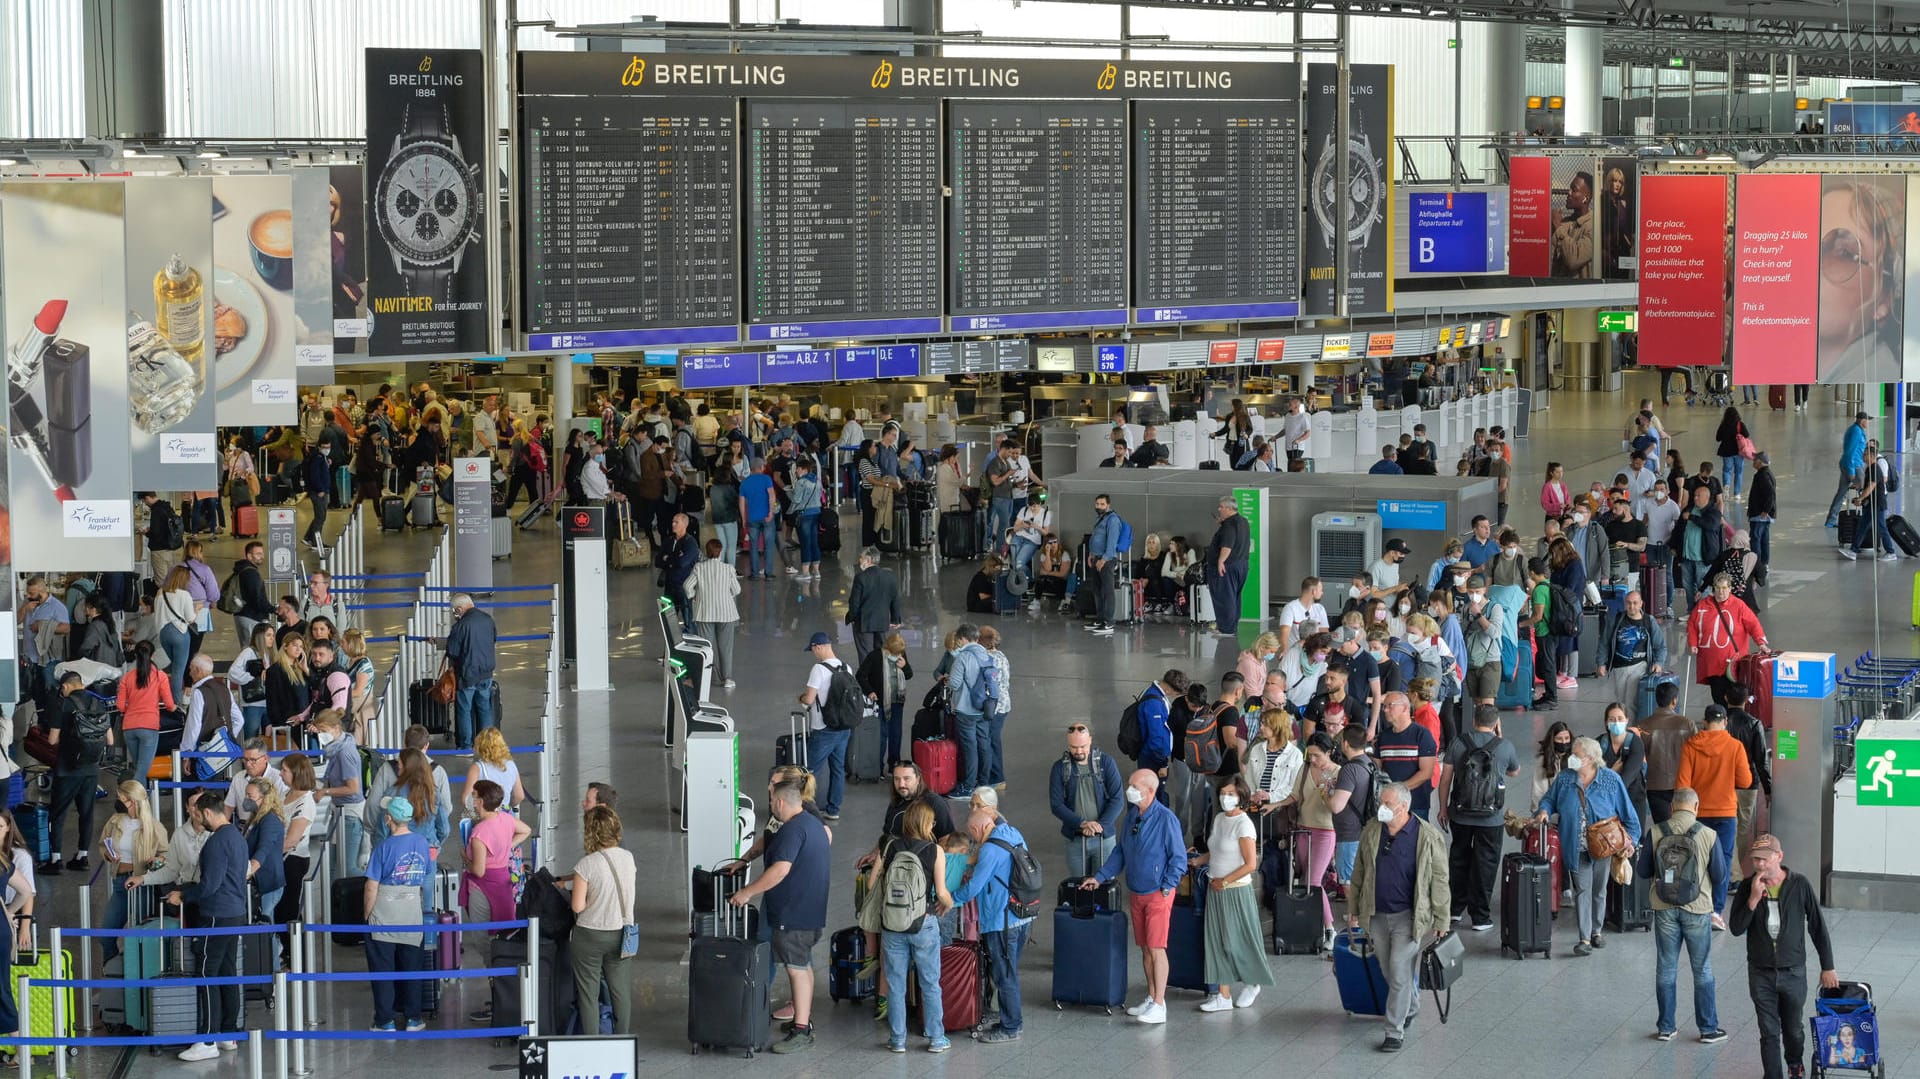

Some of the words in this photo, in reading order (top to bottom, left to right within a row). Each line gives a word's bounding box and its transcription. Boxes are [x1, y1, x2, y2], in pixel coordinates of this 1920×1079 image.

[654, 64, 786, 85] BREITLING
[901, 68, 1020, 88] BREITLING
[389, 74, 464, 86] BREITLING
[1124, 71, 1232, 89] BREITLING
[416, 89, 436, 97] 1884
[1322, 85, 1373, 94] BRLING
[1663, 220, 1686, 229] place,
[1744, 231, 1778, 241] Dragging
[1420, 237, 1435, 263] B
[1759, 246, 1783, 255] hurry?
[1645, 259, 1687, 267] possibilities
[1679, 272, 1704, 280] higher.
[1762, 274, 1792, 284] yourself.
[375, 297, 432, 313] NAVITIMER
[458, 302, 482, 310] JOURNEY
[1645, 310, 1716, 319] #beforetomatojuice.
[1743, 316, 1811, 326] #beforetomatojuice.
[796, 352, 818, 365] A,B,Z
[880, 349, 893, 360] D,E
[724, 357, 730, 368] C
